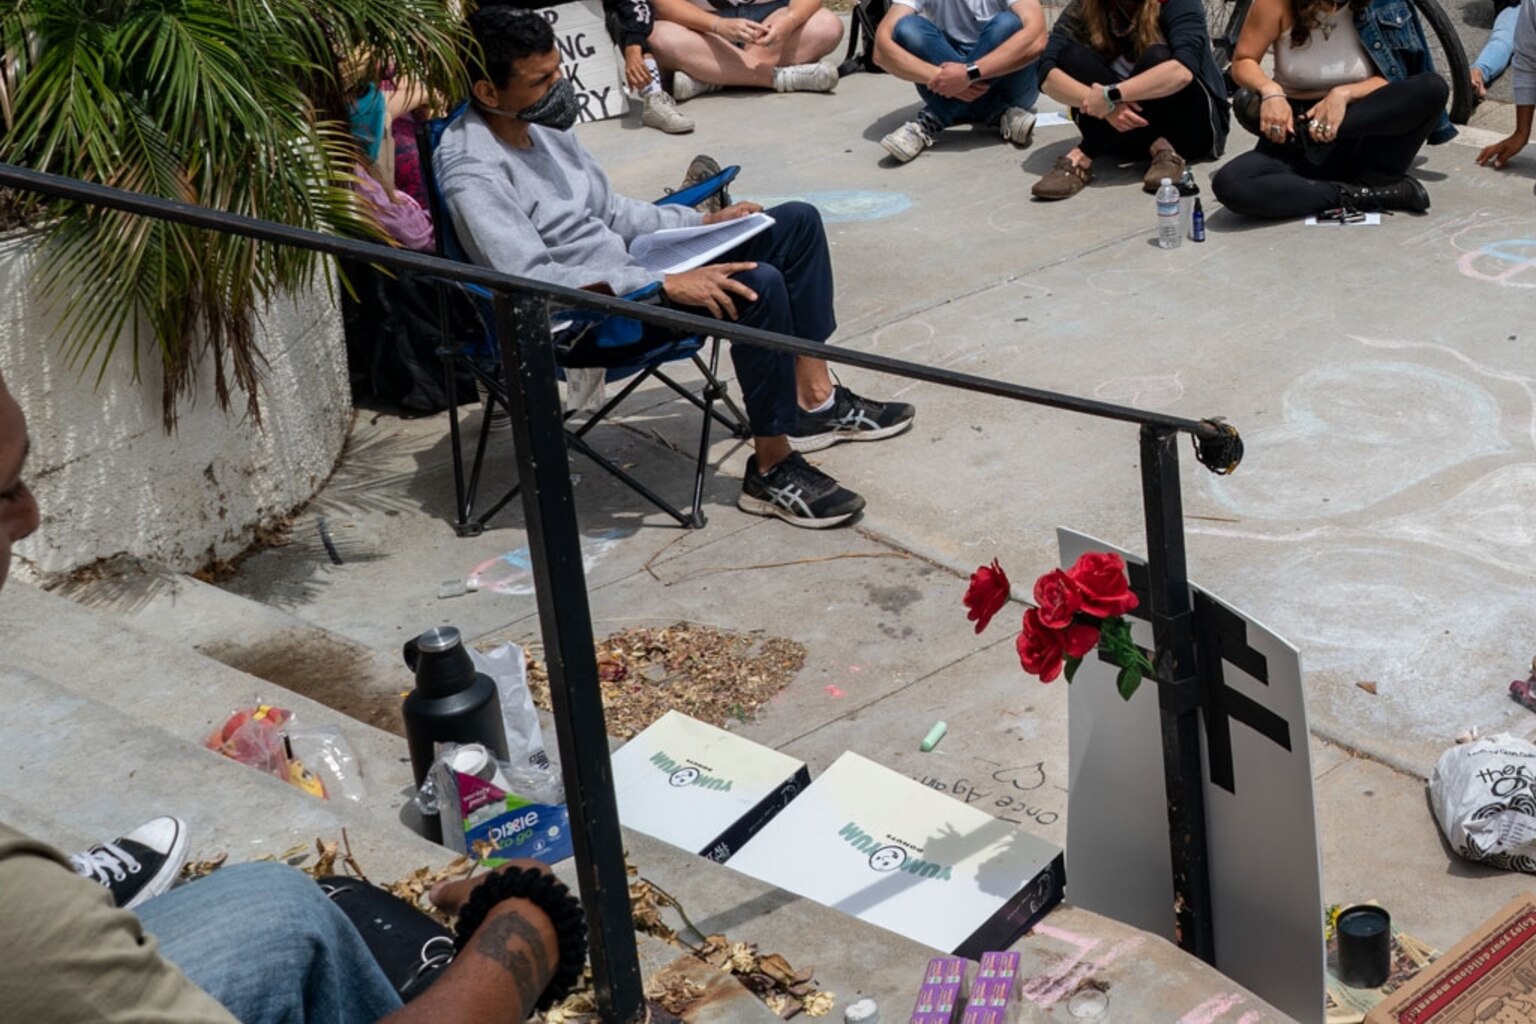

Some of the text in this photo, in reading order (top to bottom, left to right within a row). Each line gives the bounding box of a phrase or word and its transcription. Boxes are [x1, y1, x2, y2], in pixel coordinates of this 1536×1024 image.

[649, 750, 734, 793] YUM YUM
[995, 796, 1059, 826] Once
[515, 828, 534, 846] go
[885, 833, 924, 854] DONUTS
[837, 821, 953, 882] YUM YUM
[1488, 936, 1512, 954] your
[1452, 955, 1491, 983] delicious
